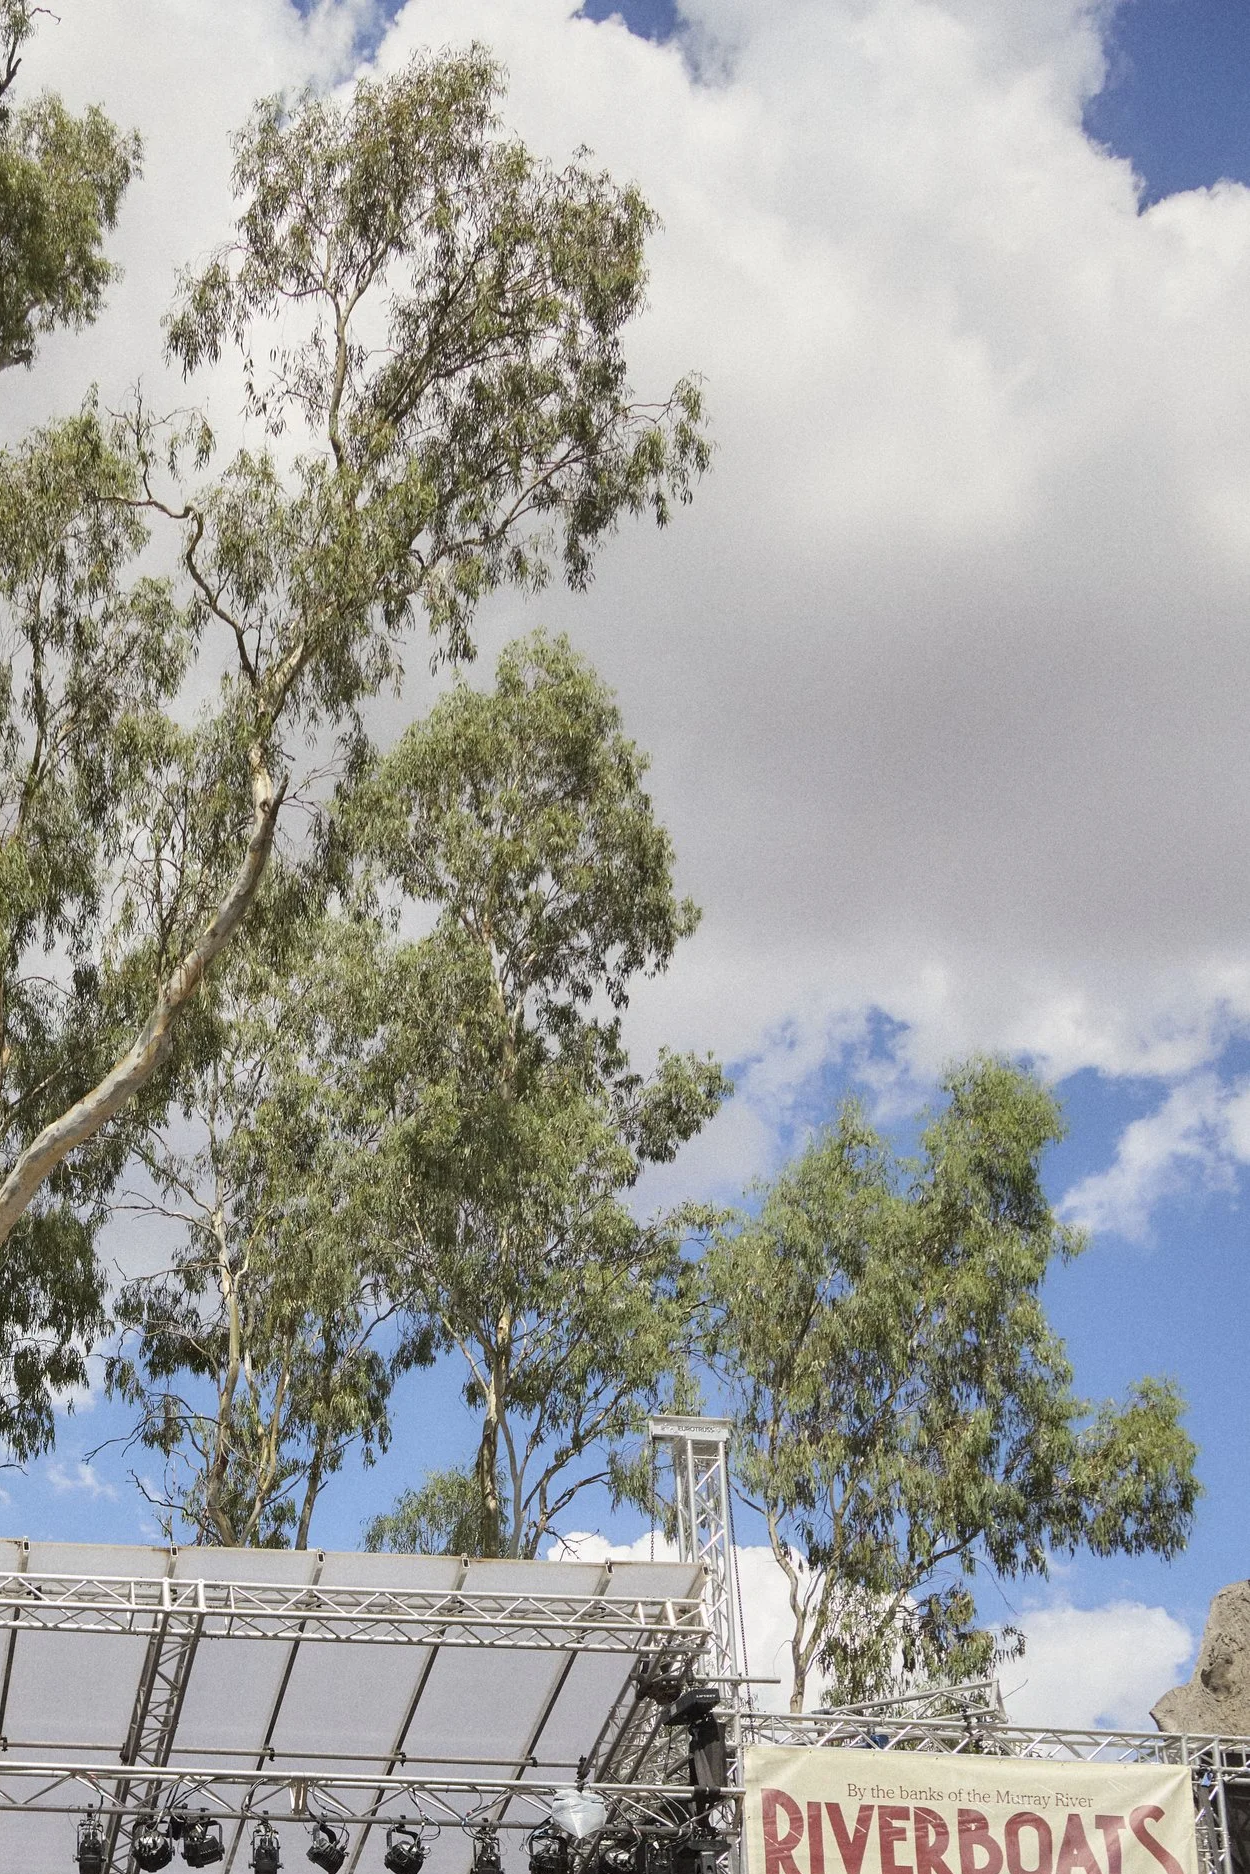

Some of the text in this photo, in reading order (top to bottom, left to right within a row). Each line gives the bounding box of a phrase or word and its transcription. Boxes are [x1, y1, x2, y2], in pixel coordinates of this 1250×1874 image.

[847, 1783, 1094, 1808] By the banks of the Murray River
